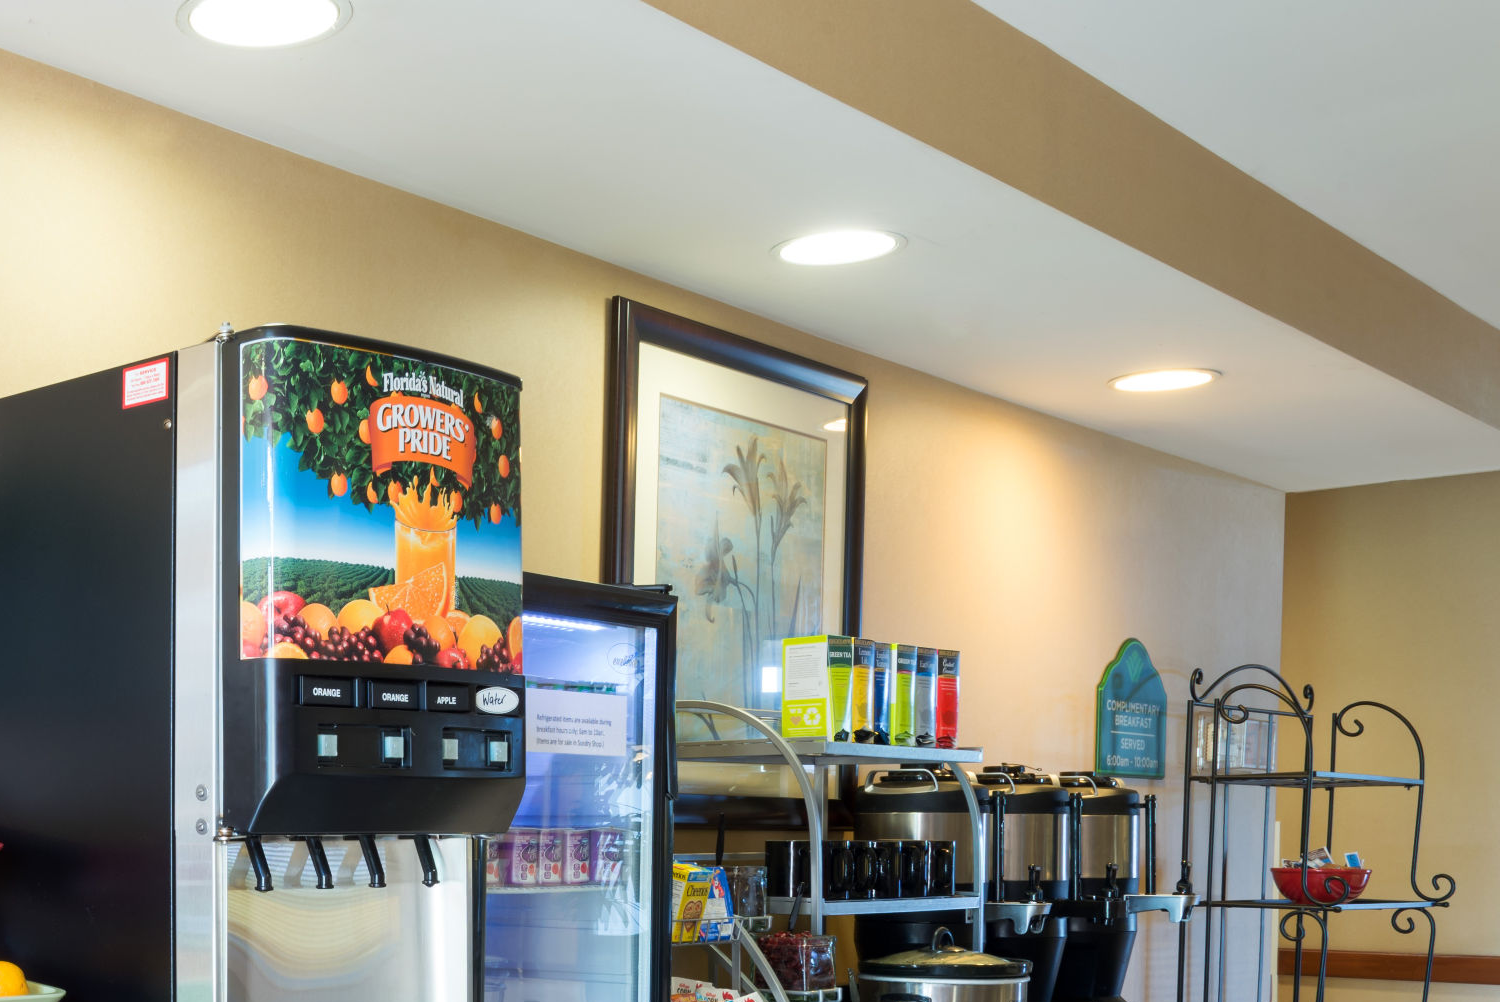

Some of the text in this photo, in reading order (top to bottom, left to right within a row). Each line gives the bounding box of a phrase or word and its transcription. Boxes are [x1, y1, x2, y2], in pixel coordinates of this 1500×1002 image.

[429, 375, 464, 408] Natural
[377, 403, 469, 442] GROWERS'
[399, 428, 452, 460] PRIDE
[312, 687, 341, 698] ORANGE
[382, 692, 409, 703] ORANGE
[437, 696, 456, 705] APPLE
[482, 693, 508, 707] Water
[1107, 699, 1161, 716] COMPLIMENTARY
[1115, 714, 1152, 728] BREAKFAST
[1121, 738, 1145, 750] SERVED
[686, 885, 708, 897] Cheerios
